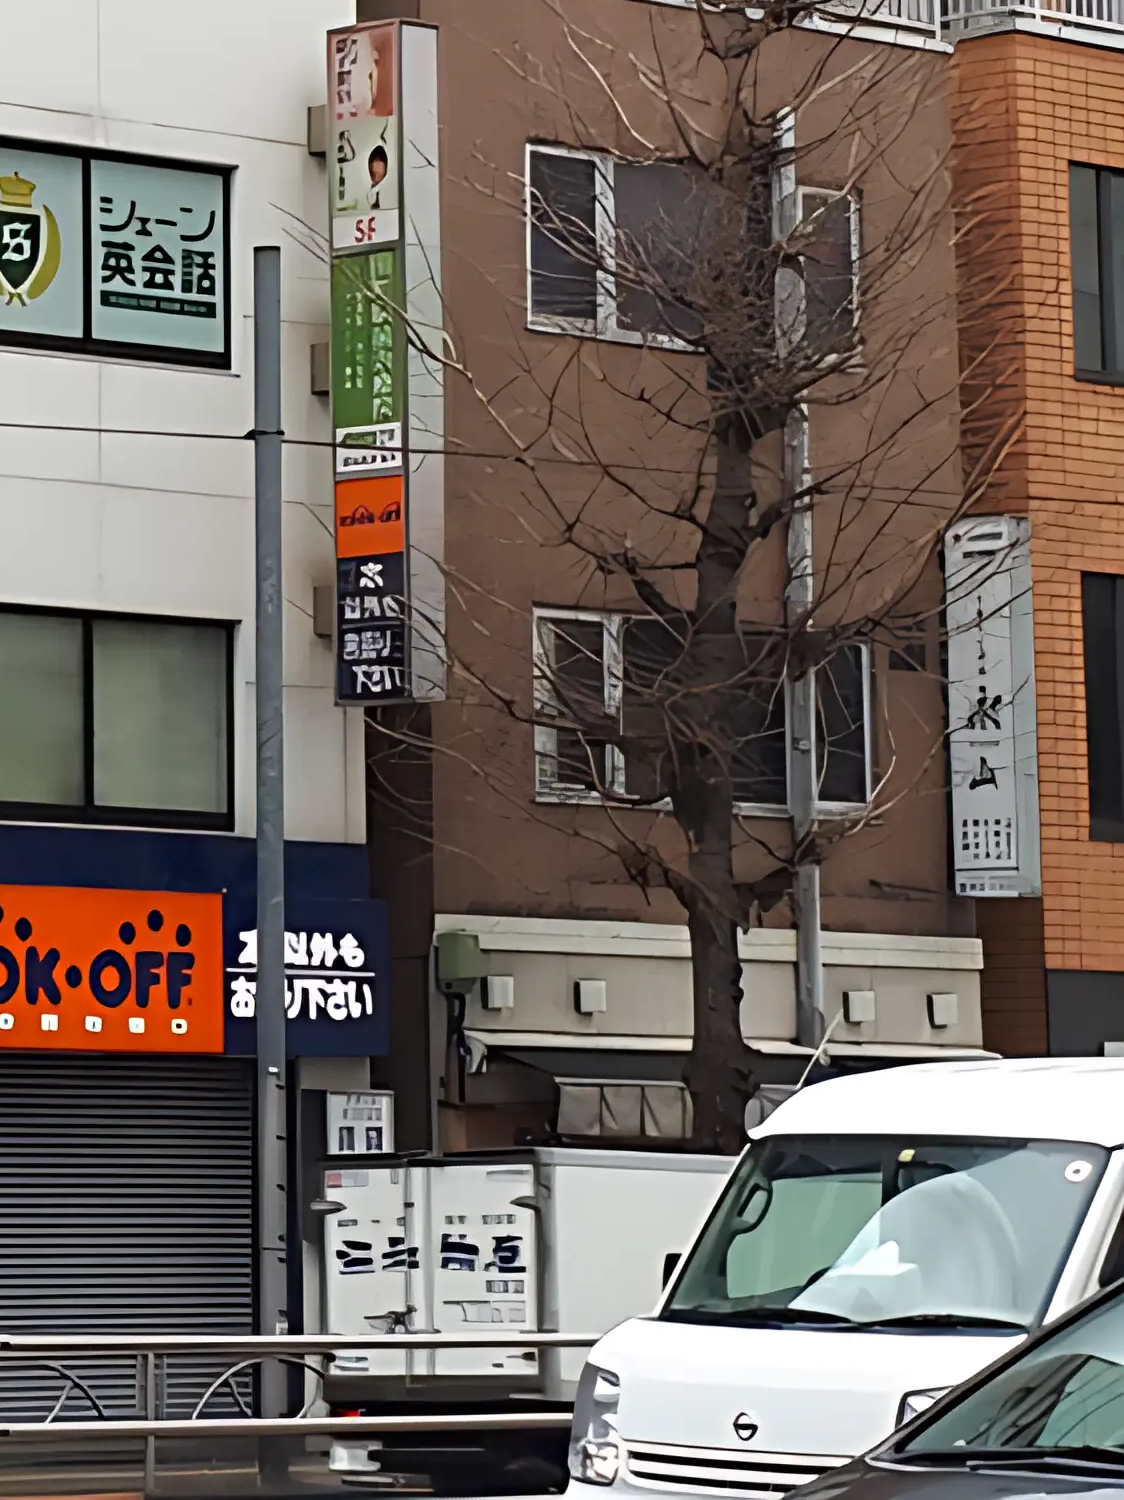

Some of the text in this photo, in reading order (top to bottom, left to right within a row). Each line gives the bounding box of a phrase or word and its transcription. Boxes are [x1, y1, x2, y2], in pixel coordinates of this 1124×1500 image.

[99, 197, 215, 242] シェーン
[101, 241, 216, 296] 英会話
